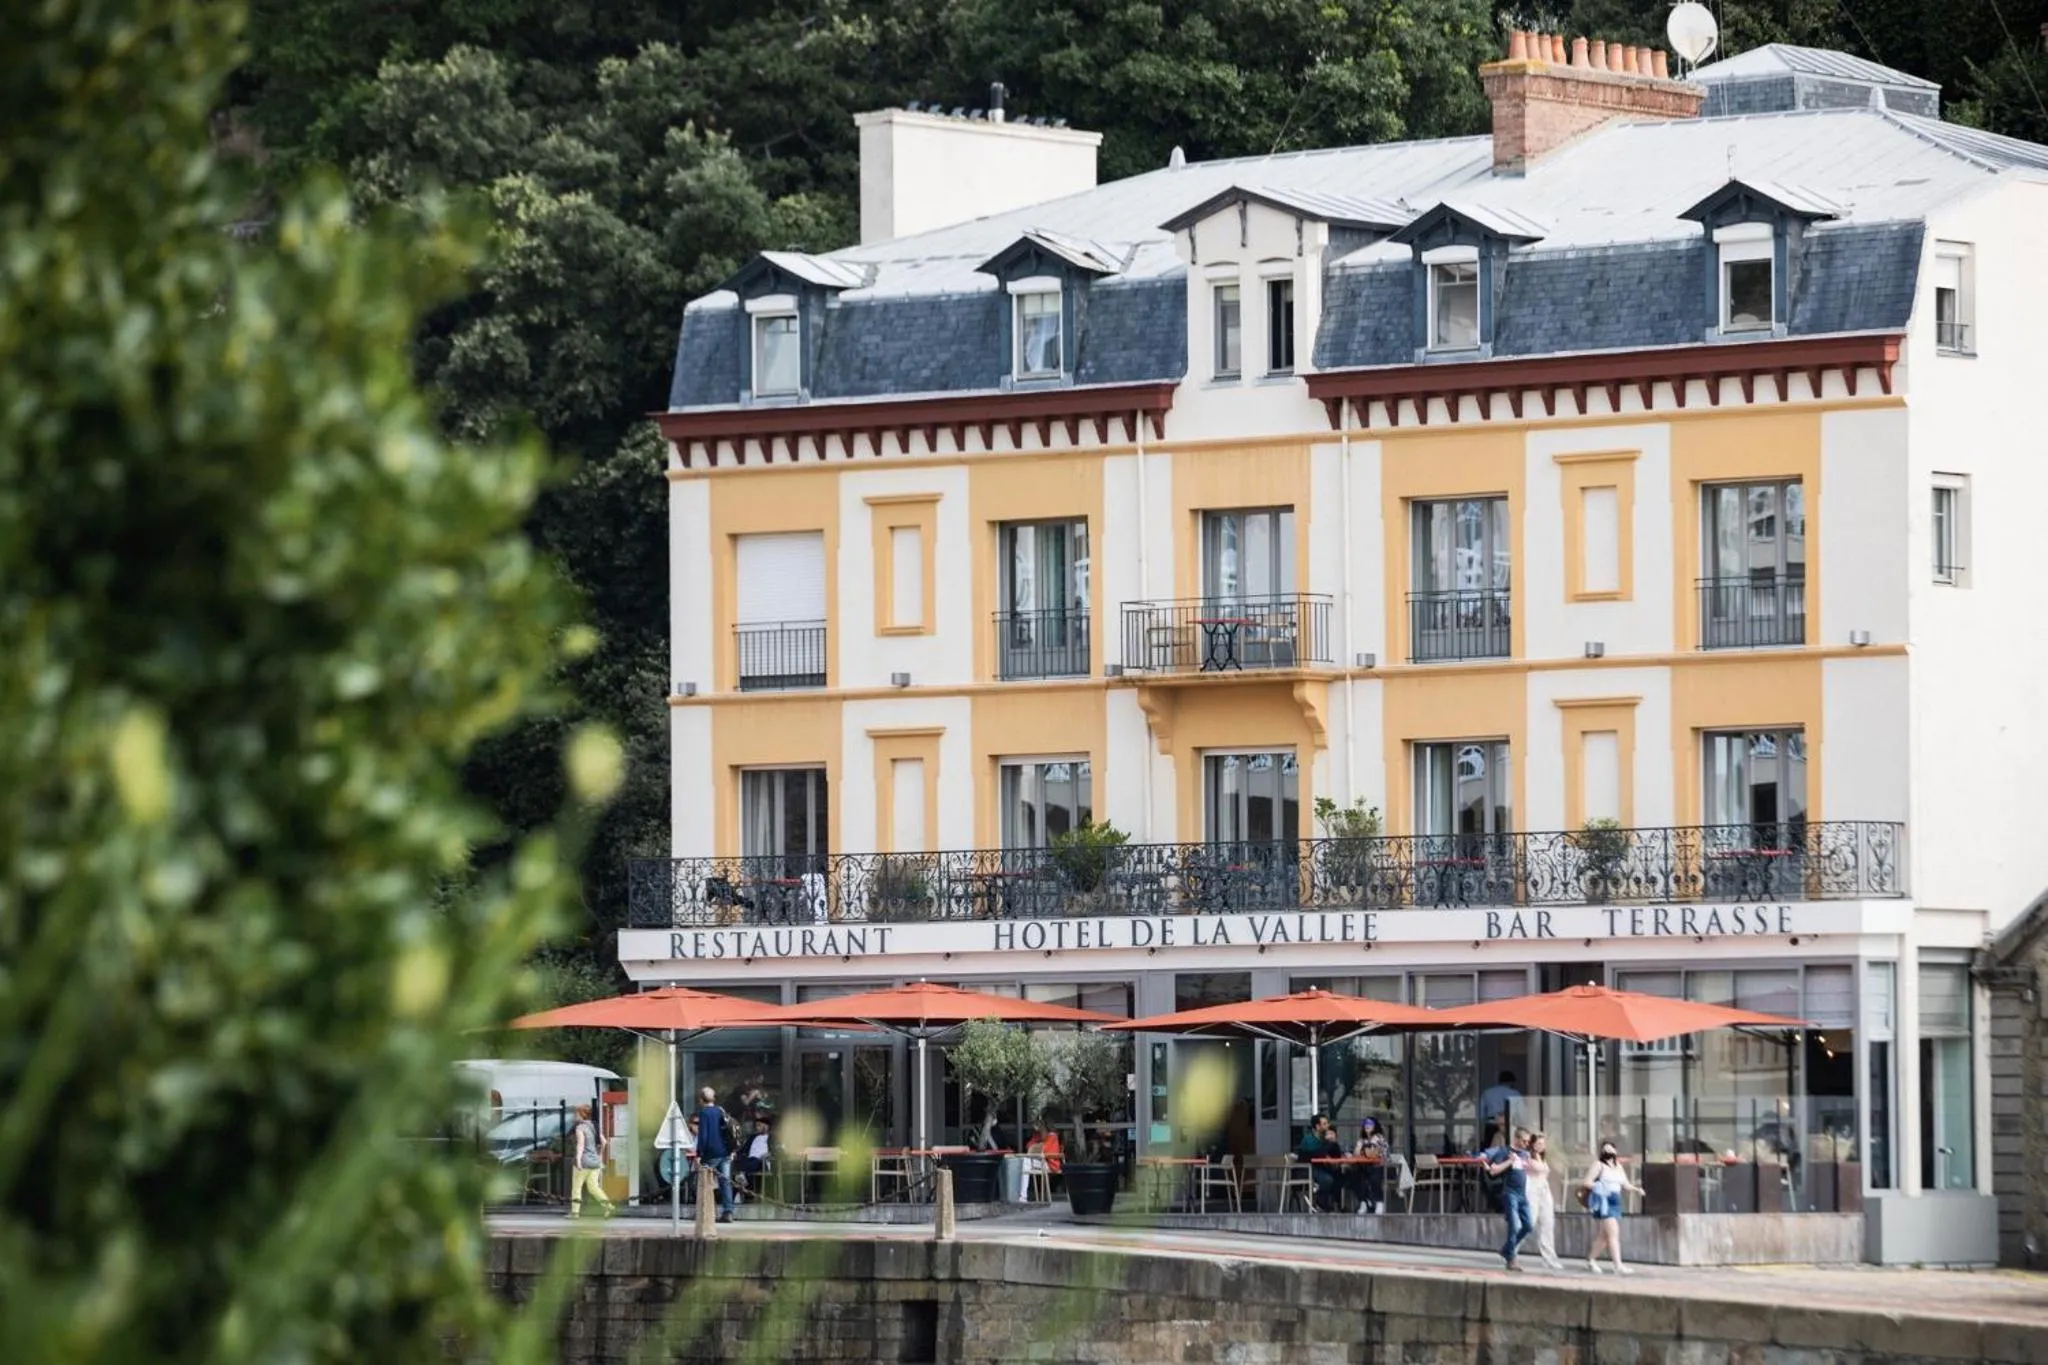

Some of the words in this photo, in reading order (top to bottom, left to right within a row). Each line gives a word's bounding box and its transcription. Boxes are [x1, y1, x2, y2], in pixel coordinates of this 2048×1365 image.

[994, 920, 1112, 951] HOTEL
[1131, 918, 1175, 947] DE
[1193, 916, 1231, 946] LA
[1248, 912, 1378, 944] VALLEE
[1486, 911, 1556, 939] BAR
[1602, 906, 1794, 937] TERRASSE
[670, 927, 893, 959] RESTAURANT
